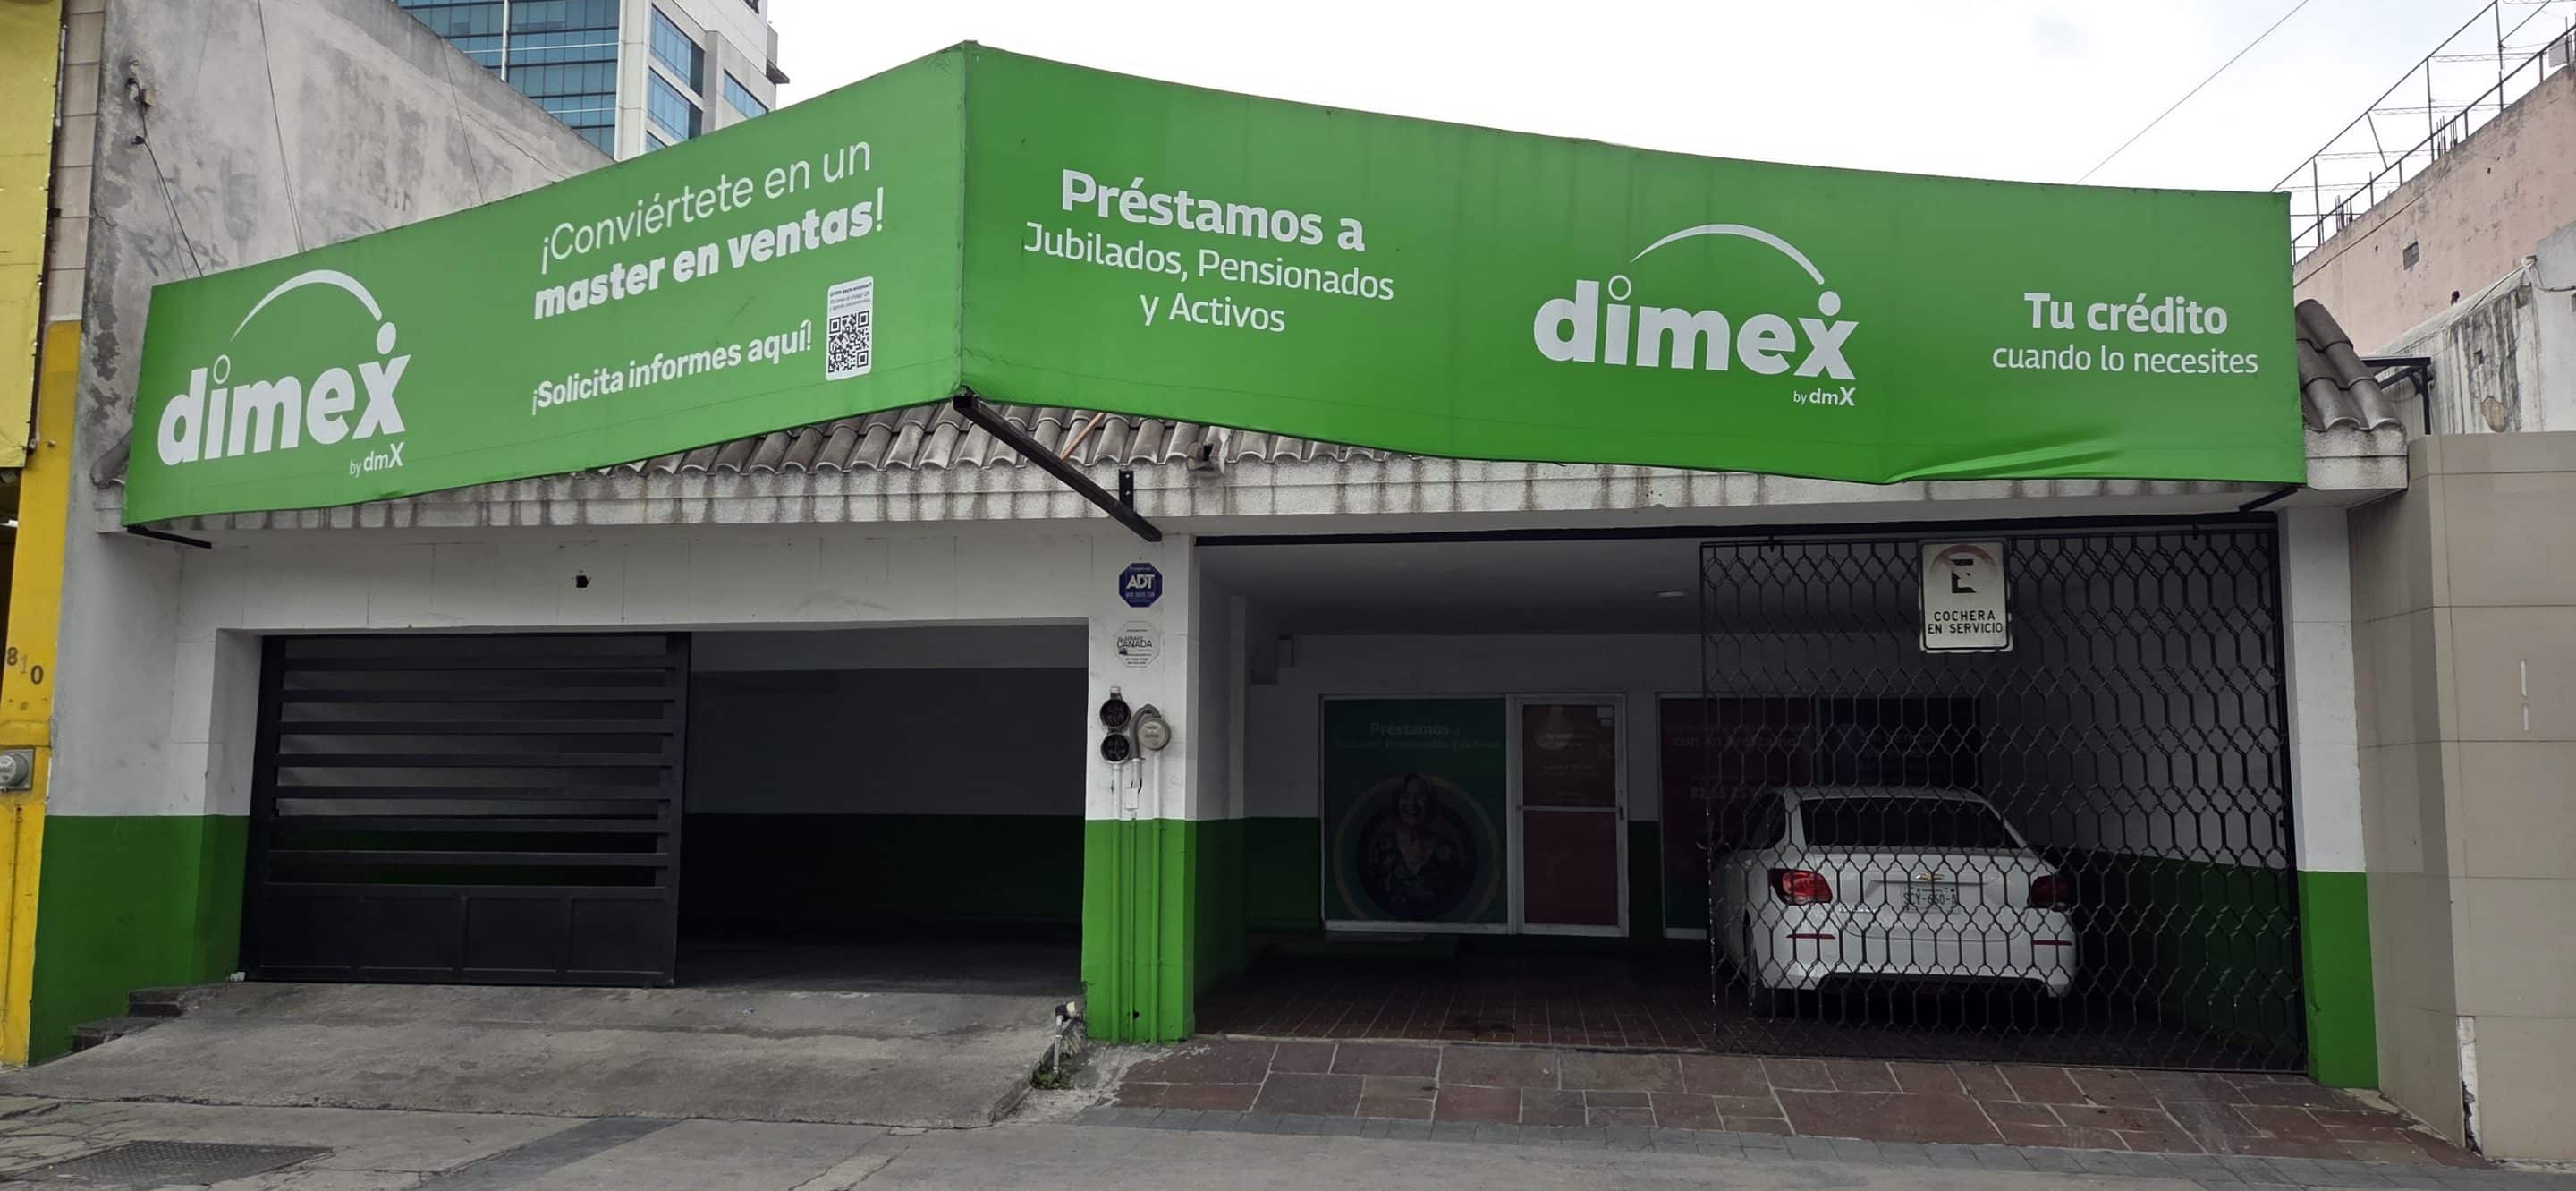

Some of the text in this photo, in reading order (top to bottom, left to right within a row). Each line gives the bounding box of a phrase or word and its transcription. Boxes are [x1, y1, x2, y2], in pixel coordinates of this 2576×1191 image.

[541, 141, 870, 275] ¡Conviértete en un
[1062, 168, 1366, 251] Préstamos a
[534, 186, 884, 320] master en ventas!
[1024, 221, 1394, 301] Jubilados, Pensionados
[1140, 293, 1286, 333] y Activos
[1534, 274, 1860, 380] dimex
[2023, 292, 2228, 335] Tu crédito
[532, 319, 812, 416] ¡Solicita informes aquí!
[1992, 344, 2259, 374] cuando lo necesites
[157, 345, 411, 466] dimex
[1793, 386, 1856, 406] by dmX
[349, 442, 404, 479] by dmX
[1125, 574, 1156, 590] ADT
[1928, 622, 2004, 634] EN SERVICIO
[1933, 610, 1996, 622] COCHERA
[1116, 639, 1153, 649] CANADA
[1368, 719, 1453, 736] Préstamos
